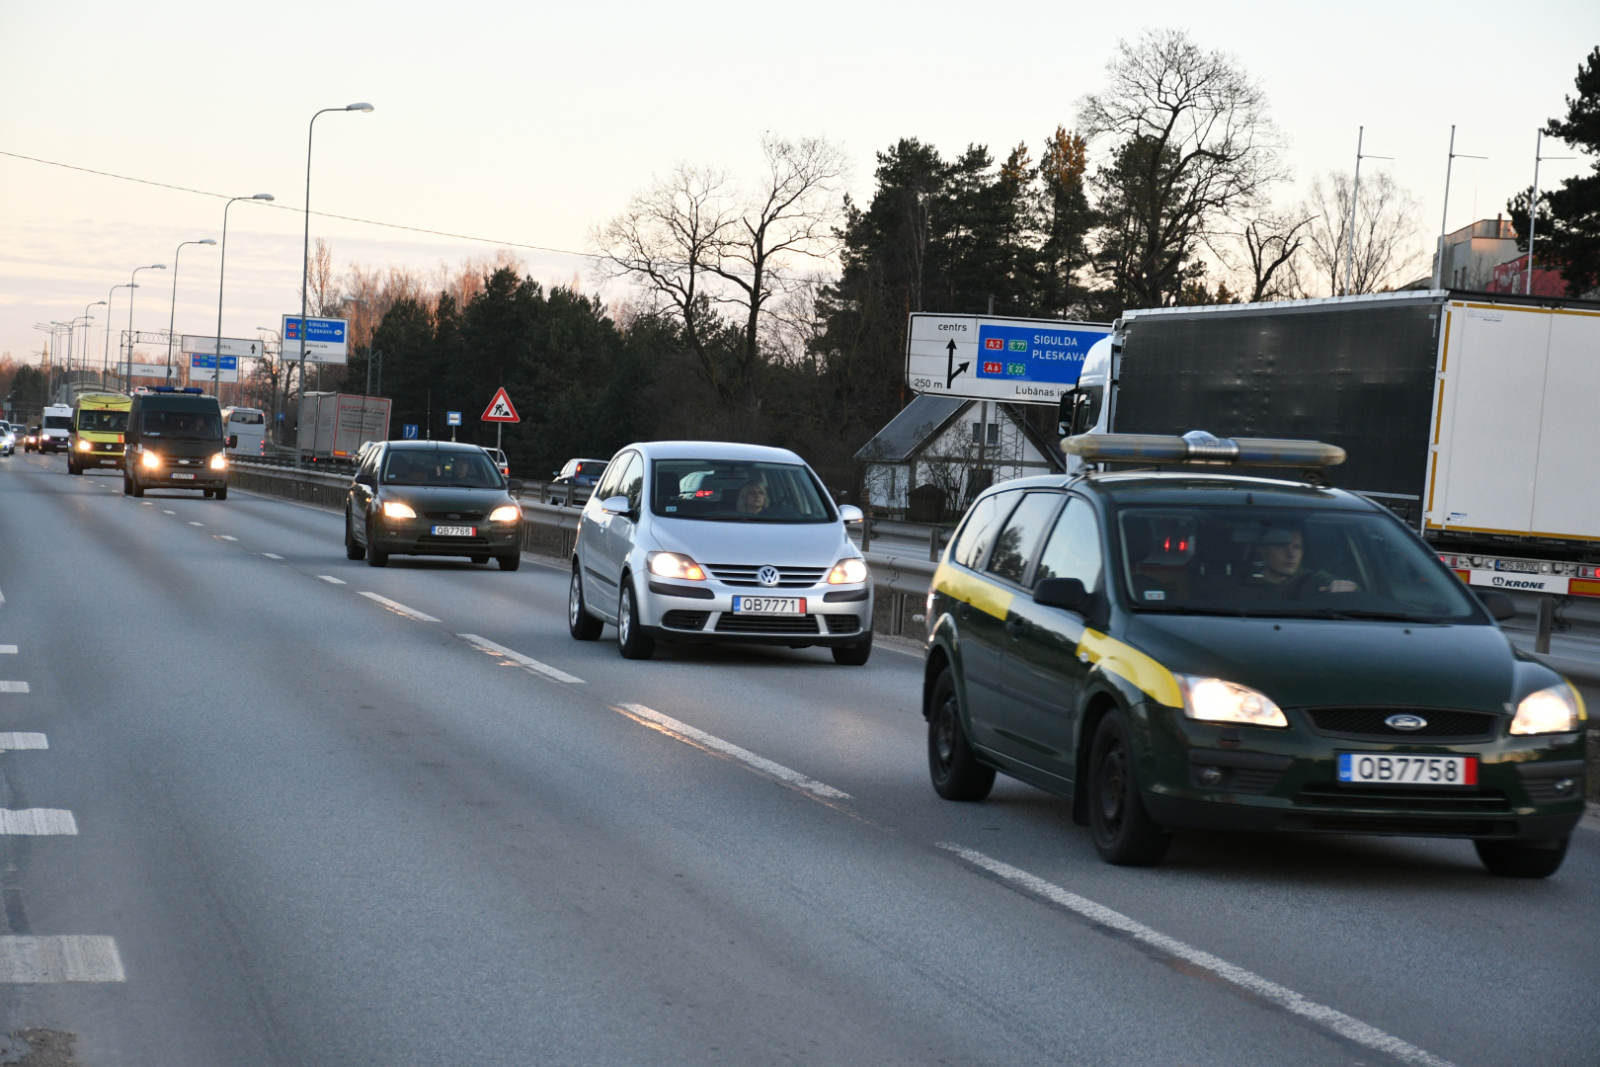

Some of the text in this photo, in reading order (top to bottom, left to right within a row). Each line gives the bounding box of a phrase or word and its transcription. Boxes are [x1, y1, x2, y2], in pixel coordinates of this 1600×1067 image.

[938, 323, 967, 332] centrs
[1034, 335, 1078, 347] SIGULDA
[1032, 350, 1085, 362] PLESKAVA
[914, 378, 943, 389] 250 m
[1505, 579, 1545, 590] KRONE
[743, 599, 795, 612] QB7771
[1358, 757, 1458, 782] QB7758
